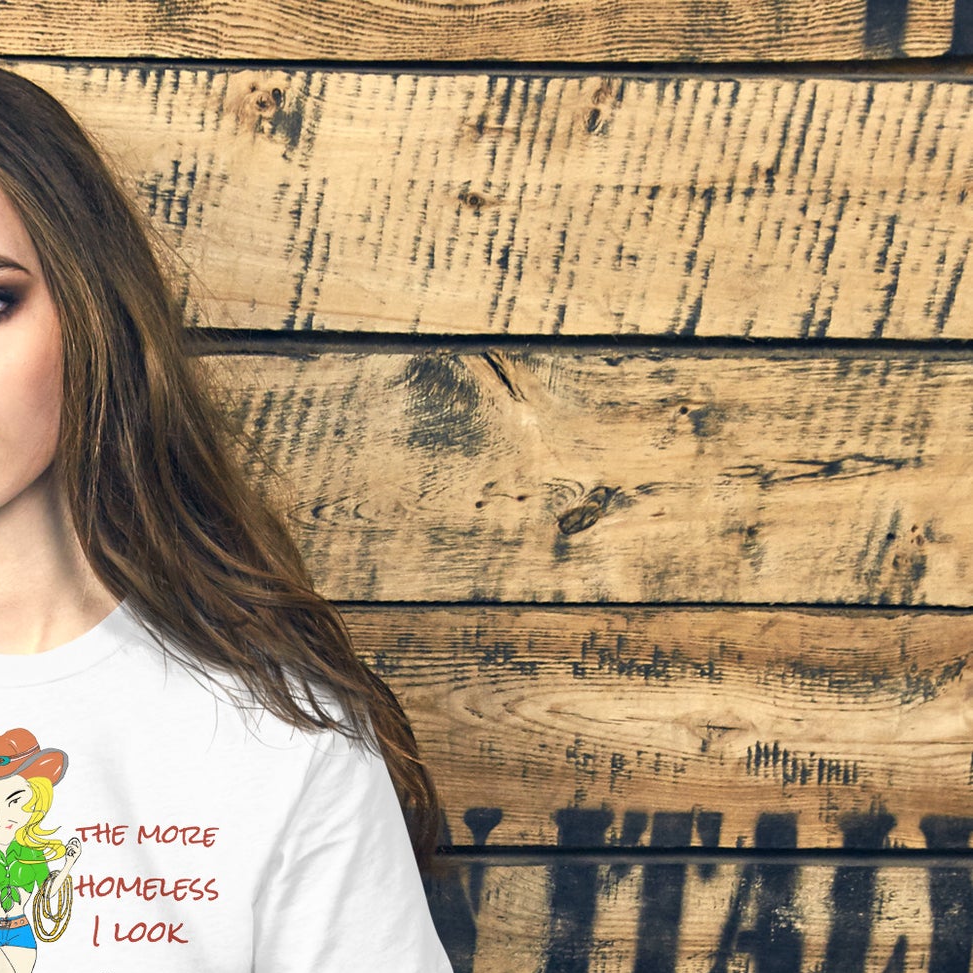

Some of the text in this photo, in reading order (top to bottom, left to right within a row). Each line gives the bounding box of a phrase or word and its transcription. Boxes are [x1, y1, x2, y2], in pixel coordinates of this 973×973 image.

[75, 822, 220, 848] THE MORE
[74, 874, 220, 902] HOMELESS
[93, 915, 189, 948] I LOOK
